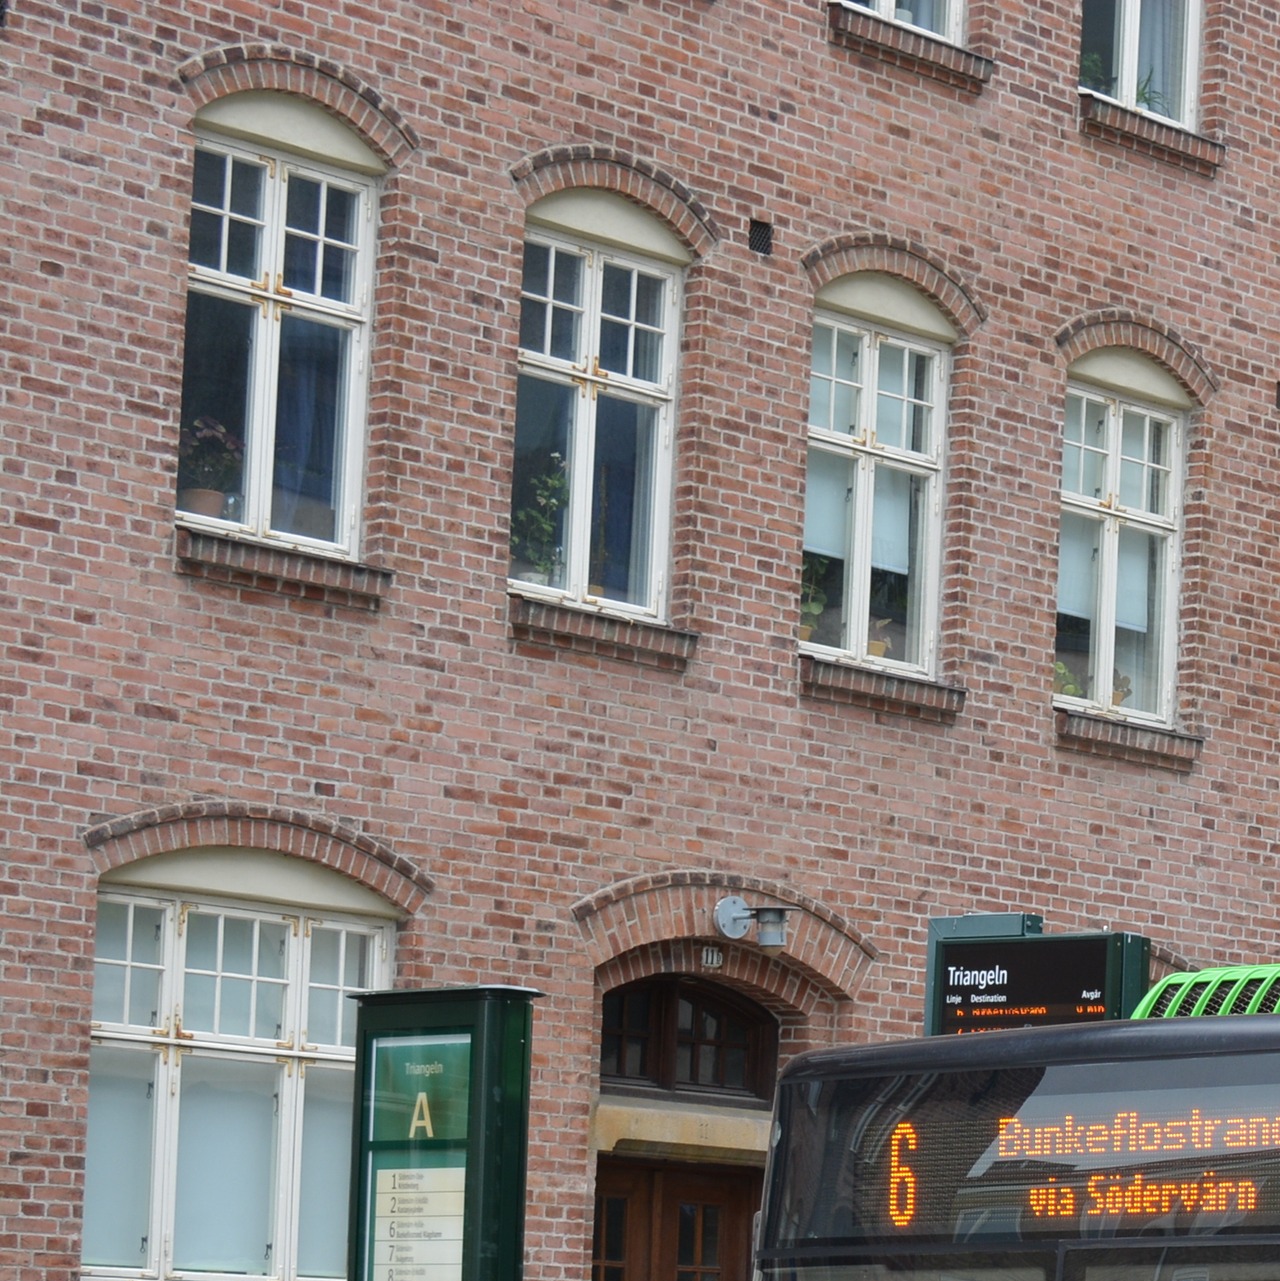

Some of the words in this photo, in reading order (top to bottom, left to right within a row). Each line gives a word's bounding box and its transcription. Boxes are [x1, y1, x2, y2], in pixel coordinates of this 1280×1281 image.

[948, 965, 1008, 989] Triangeln
[970, 993, 1007, 1003] Destination
[1081, 989, 1102, 1001] Avgår
[405, 1061, 444, 1077] Triangeln
[408, 1092, 434, 1138] A
[391, 1173, 397, 1190] 1
[889, 1121, 918, 1227] 6
[1029, 1176, 1075, 1217] via
[1087, 1171, 1258, 1216] Södervärn
[390, 1196, 397, 1214] 2
[389, 1221, 396, 1238] 6
[388, 1245, 395, 1261] 7
